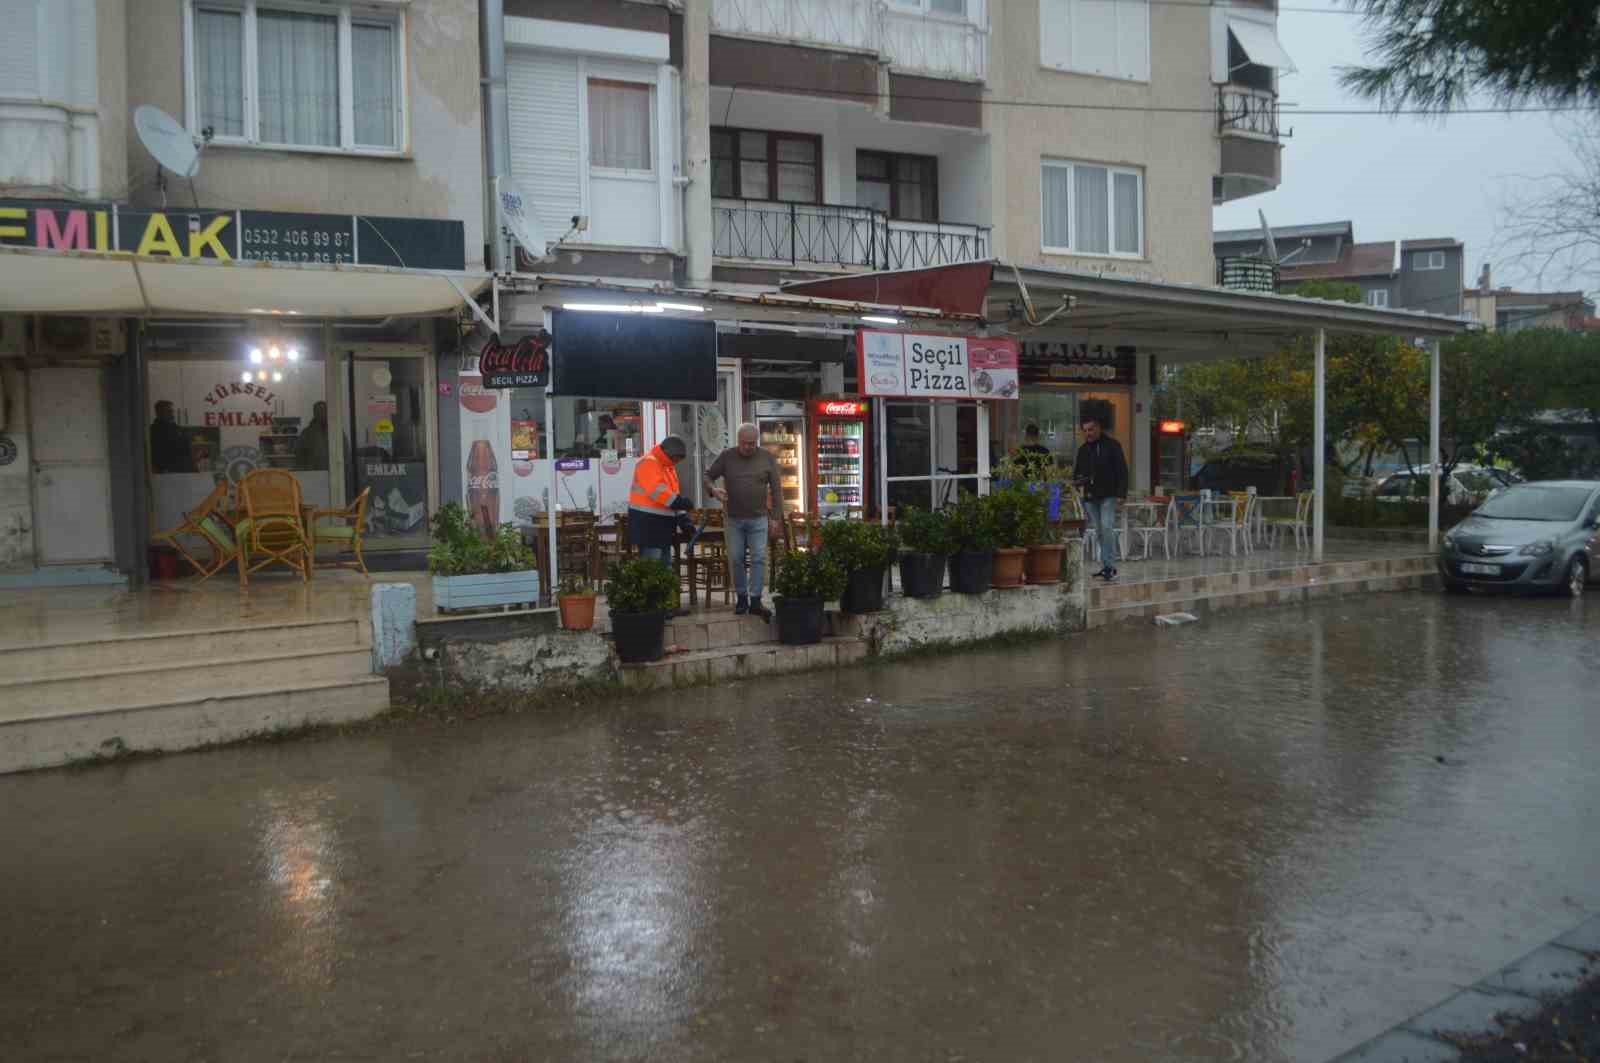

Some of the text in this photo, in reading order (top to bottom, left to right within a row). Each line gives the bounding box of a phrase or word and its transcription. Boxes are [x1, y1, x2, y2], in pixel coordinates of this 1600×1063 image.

[244, 229, 351, 247] 0532 406 89 87
[911, 342, 963, 370] Seçil
[910, 368, 967, 391] Pizza
[204, 382, 275, 406] YÜKSEL
[204, 412, 273, 427] EMLAK
[367, 463, 408, 476] EMLAK
